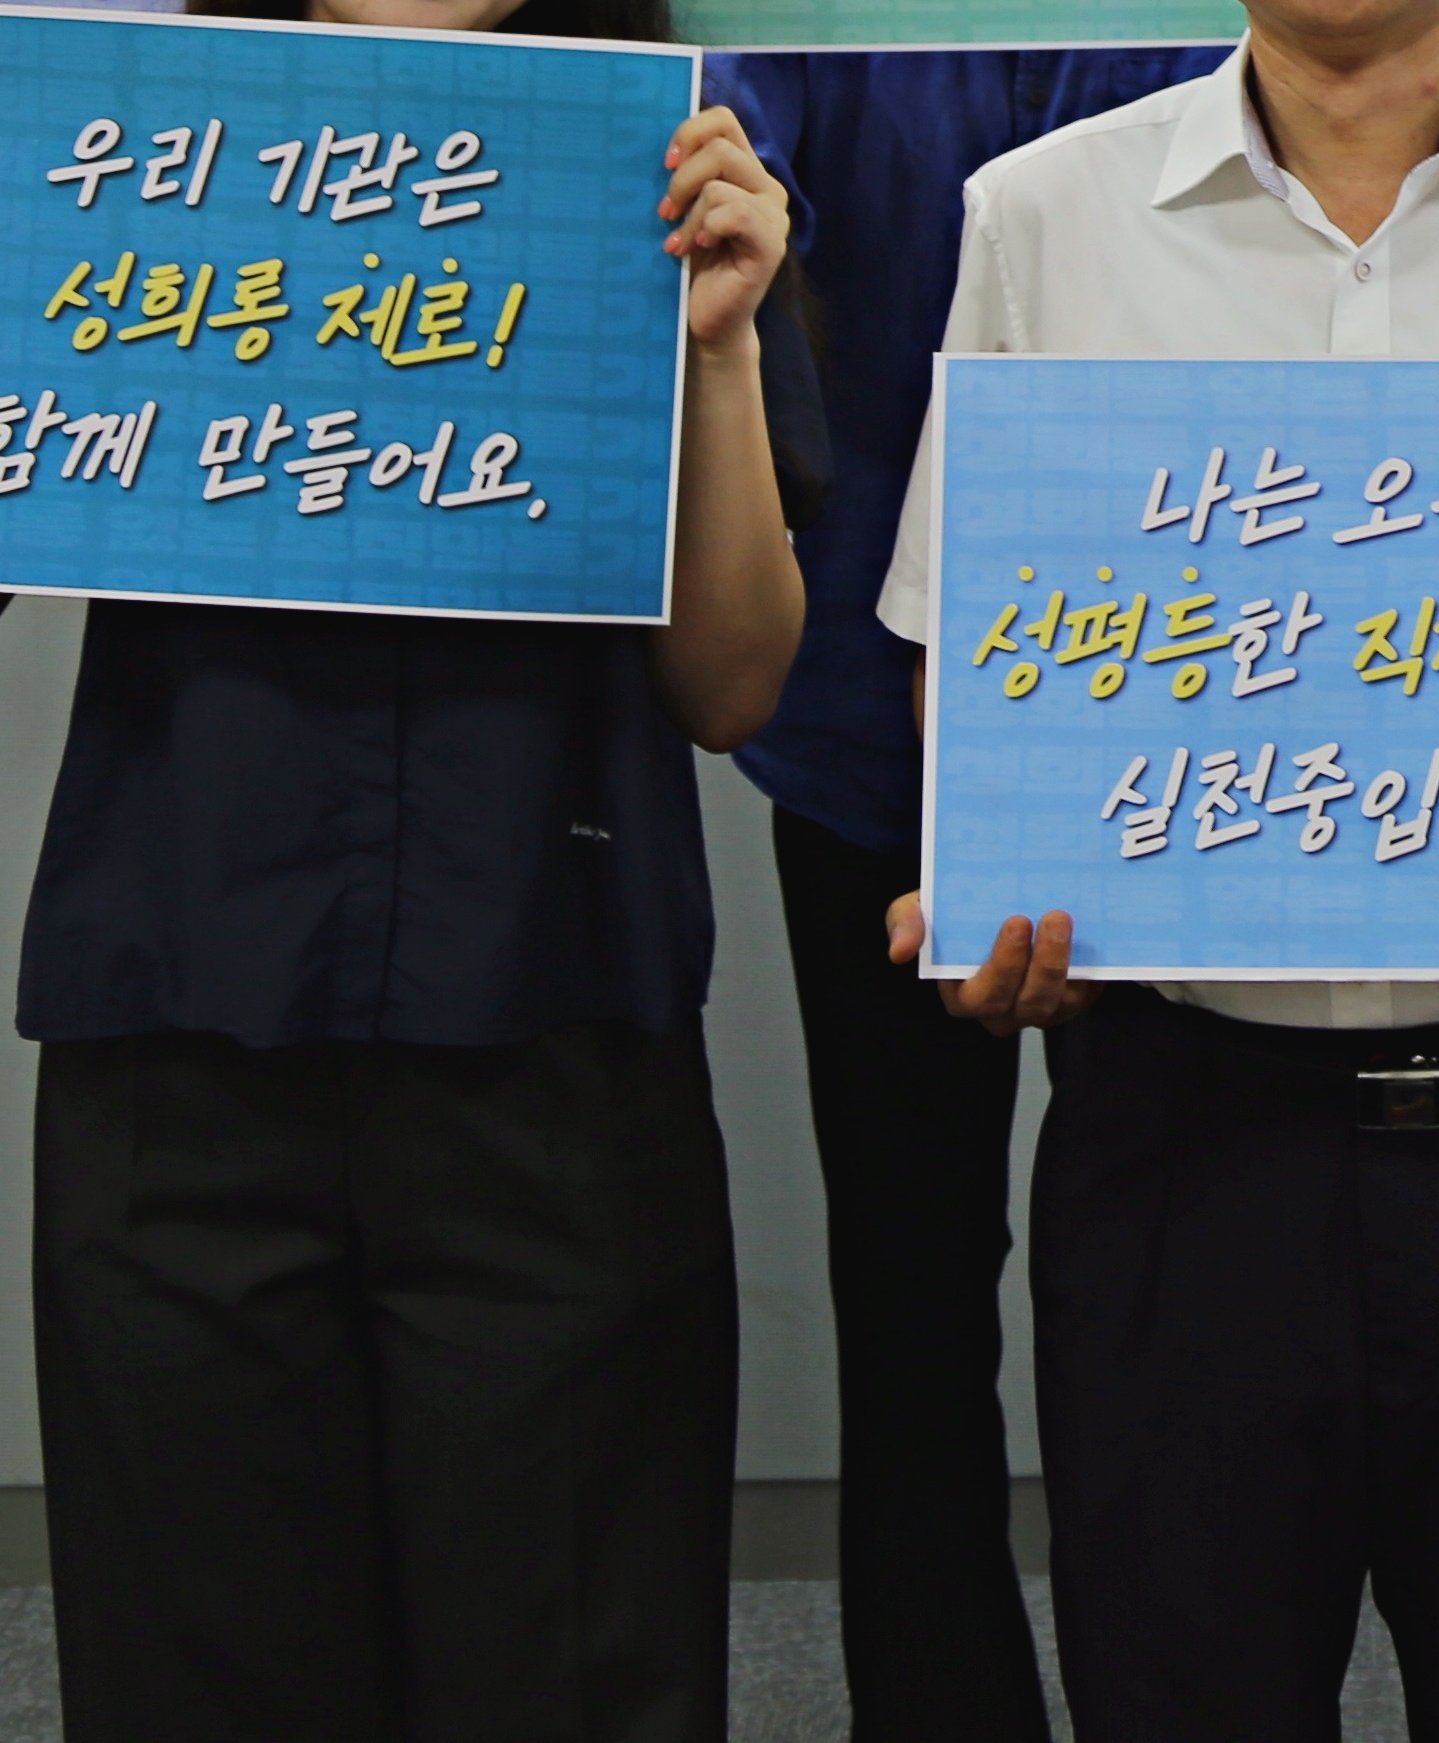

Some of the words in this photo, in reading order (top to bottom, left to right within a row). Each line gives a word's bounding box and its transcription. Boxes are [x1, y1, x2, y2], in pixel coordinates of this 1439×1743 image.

[47, 118, 223, 209] 우리
[258, 125, 499, 228] 기관은
[43, 251, 289, 362] 성희롱
[316, 270, 527, 368] 제로!
[1140, 446, 1321, 546] 나는
[971, 589, 1323, 701] 성평등한
